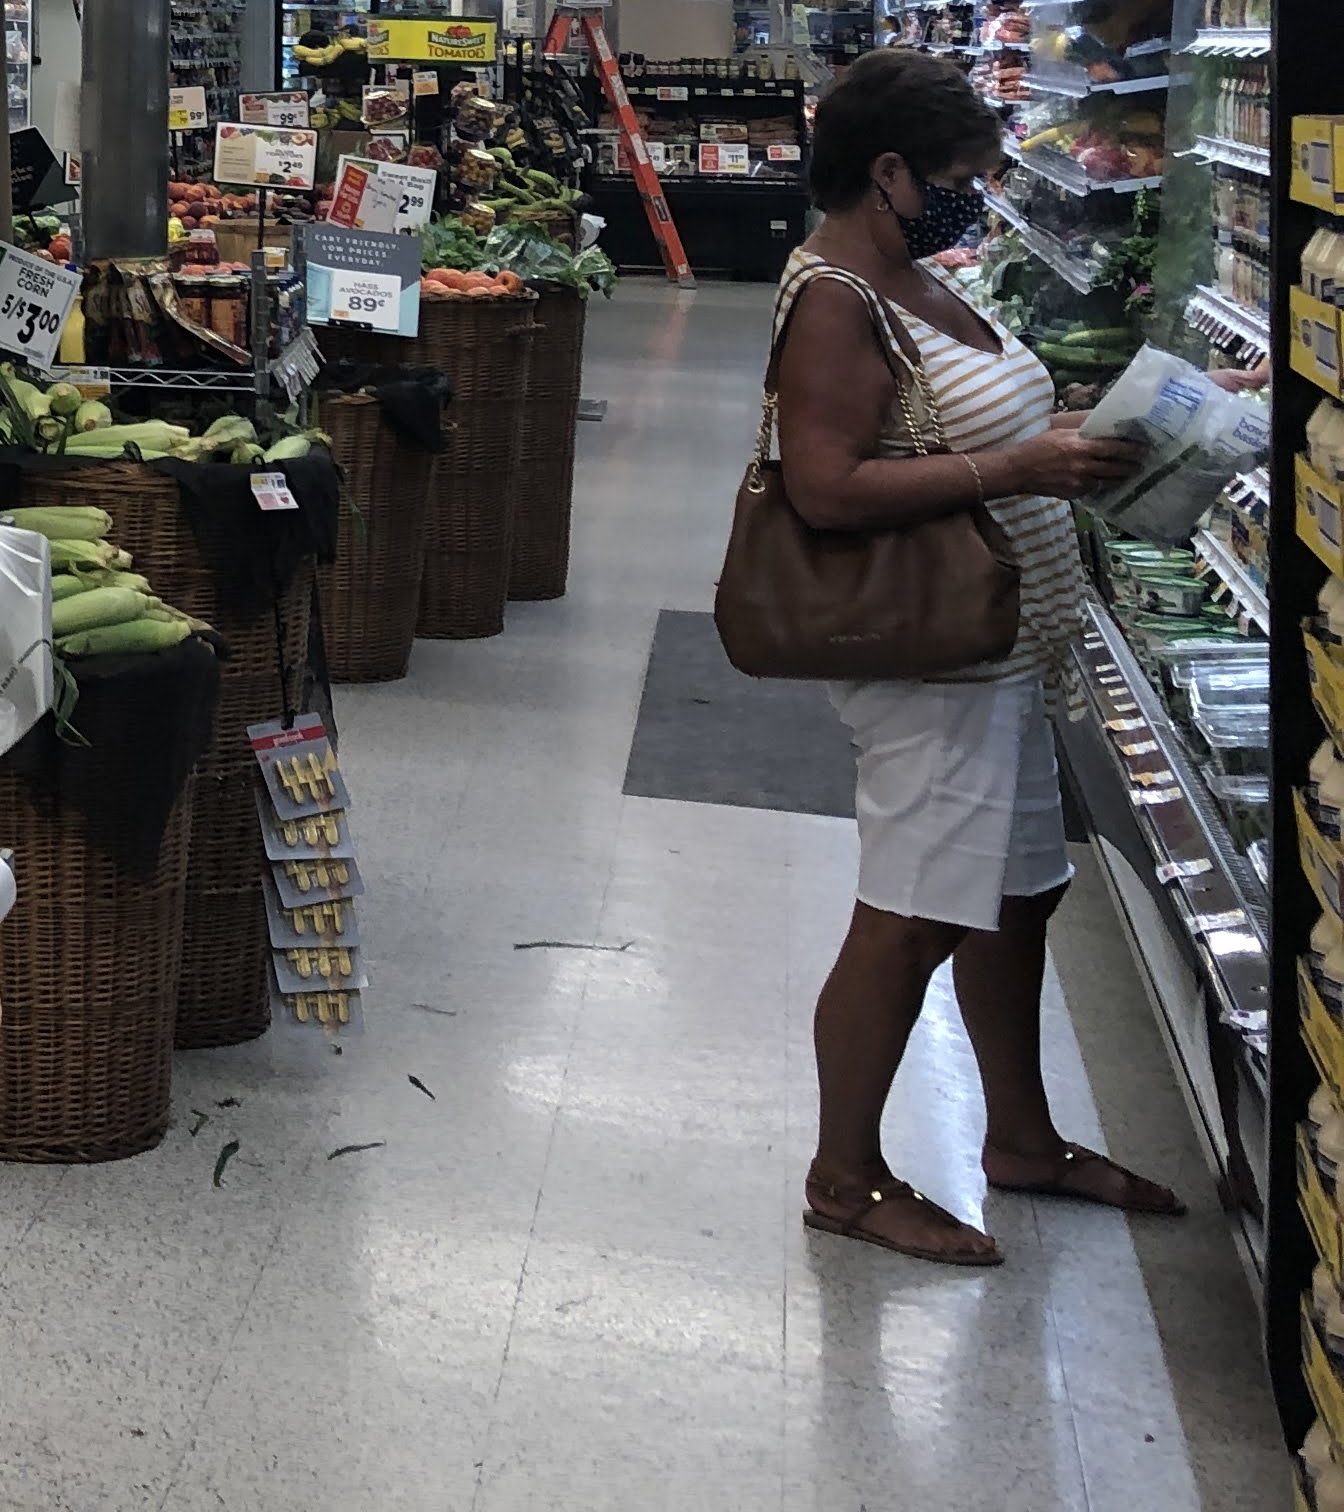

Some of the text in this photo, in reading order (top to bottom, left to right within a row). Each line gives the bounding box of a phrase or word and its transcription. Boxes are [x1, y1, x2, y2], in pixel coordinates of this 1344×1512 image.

[428, 45, 486, 59] TOMATOES
[18, 267, 55, 289] FRESH
[16, 277, 50, 298] CORN
[339, 287, 393, 298] AVOCADOS
[353, 282, 379, 290] HASS
[348, 296, 386, 313] 89¢
